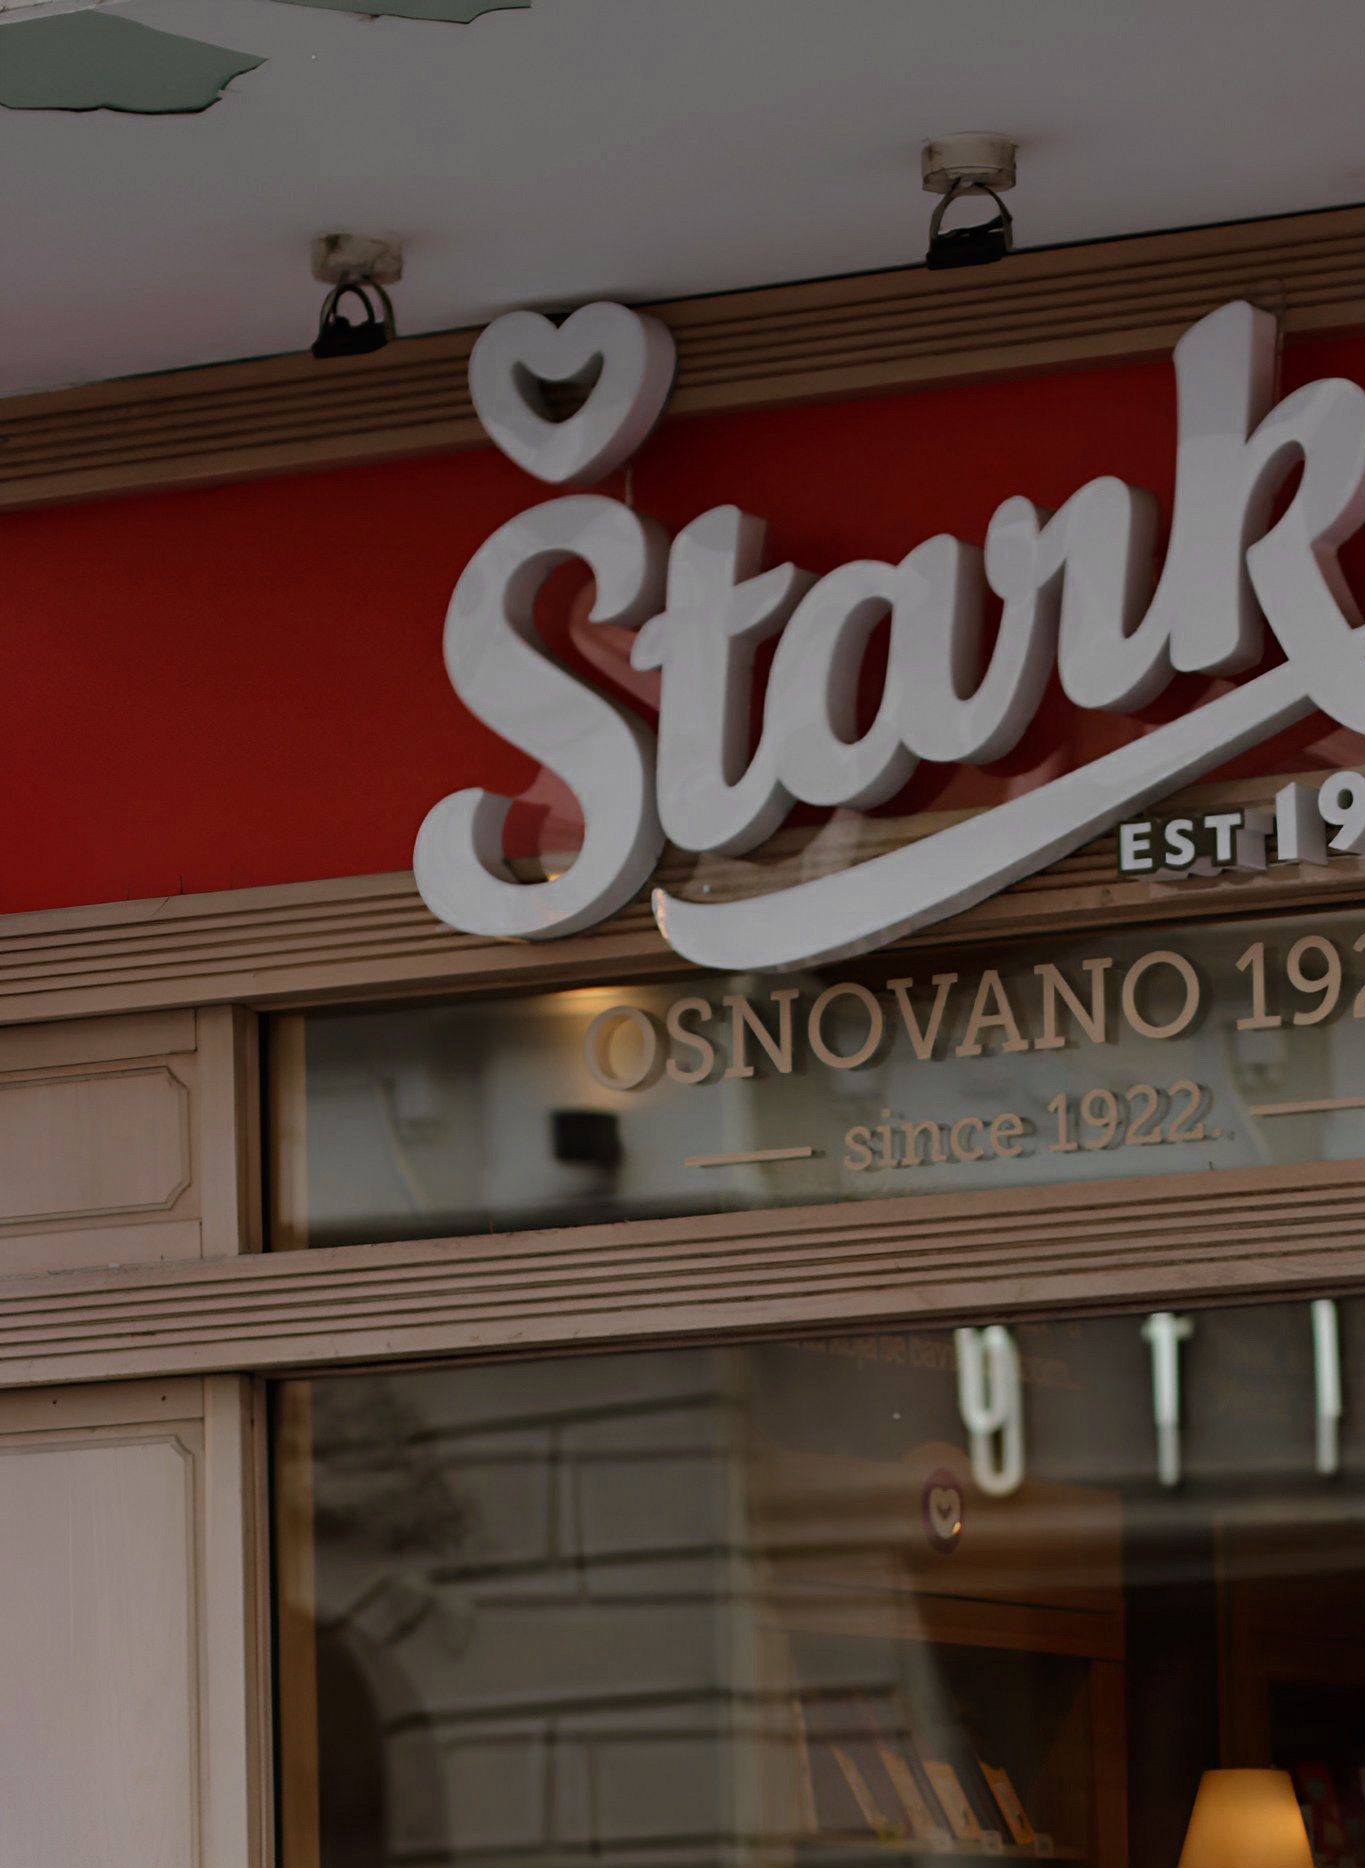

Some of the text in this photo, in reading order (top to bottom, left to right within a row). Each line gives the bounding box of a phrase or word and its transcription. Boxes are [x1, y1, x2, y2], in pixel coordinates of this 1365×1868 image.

[1117, 813, 1248, 876] EST
[585, 950, 1202, 1091] OSNOVANO
[842, 1081, 1224, 1172] since 1922.
